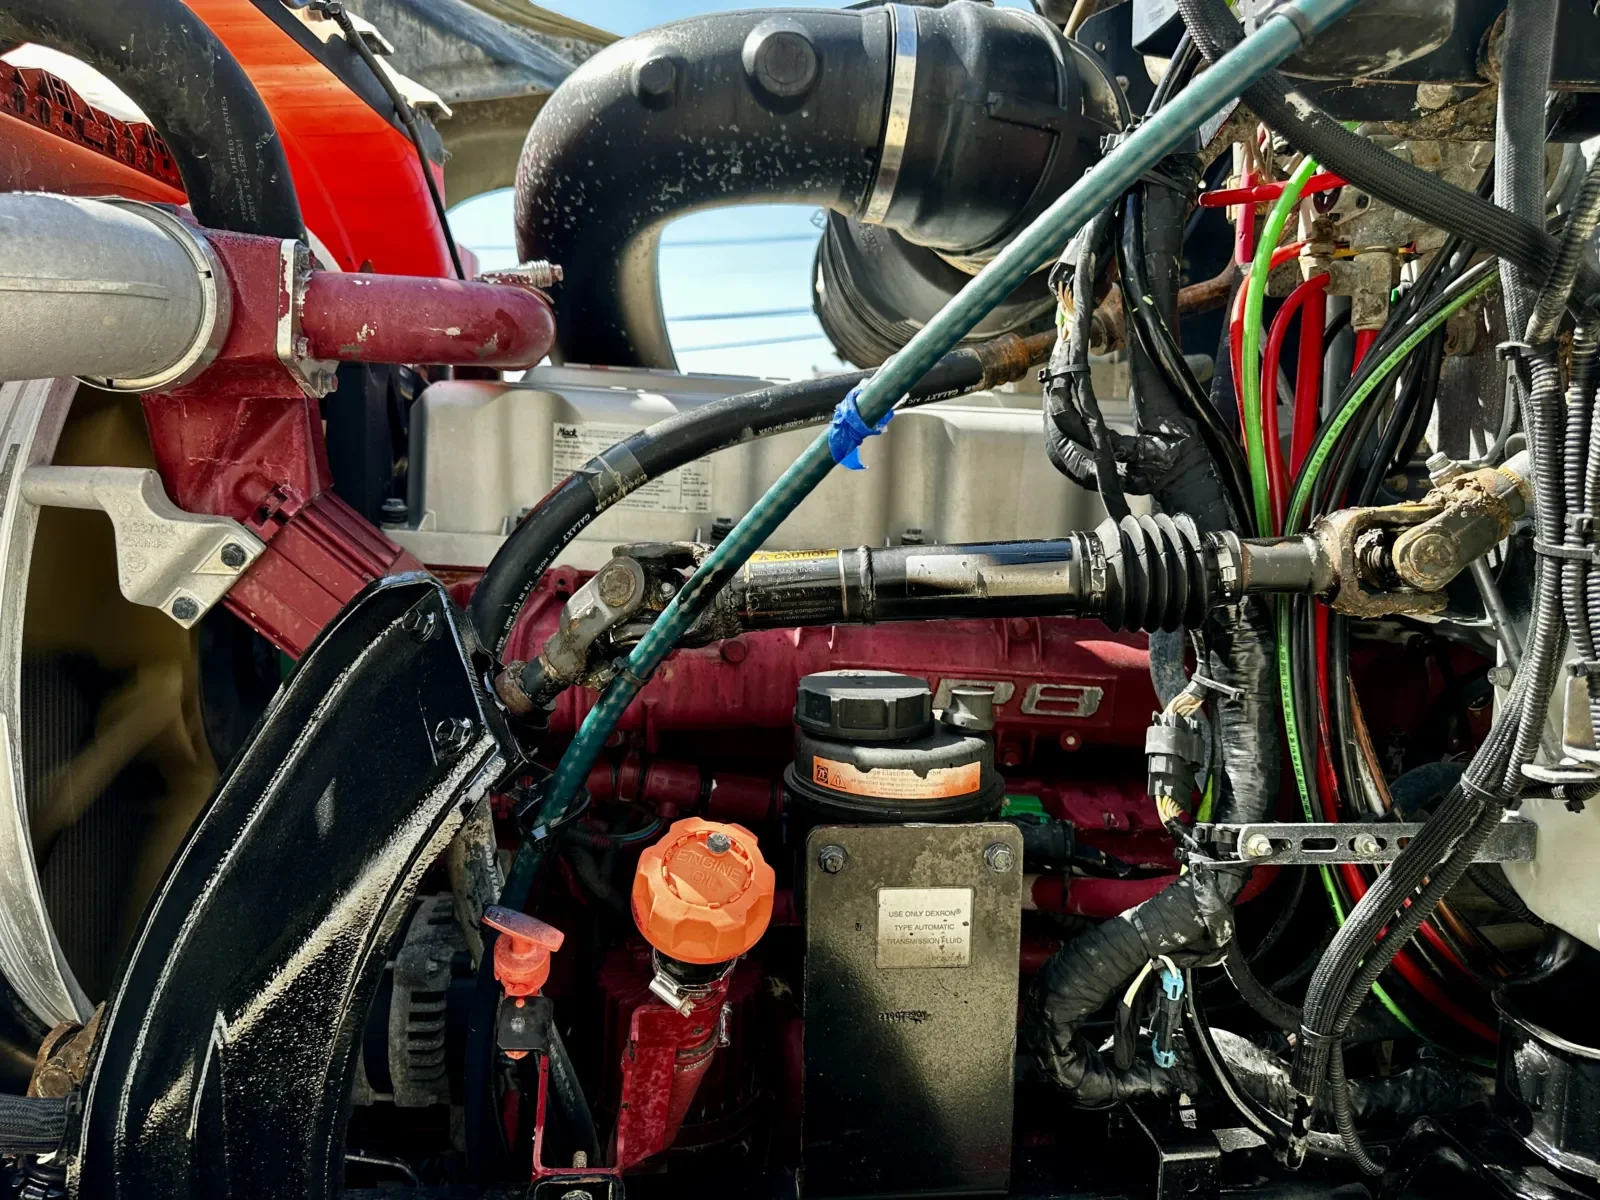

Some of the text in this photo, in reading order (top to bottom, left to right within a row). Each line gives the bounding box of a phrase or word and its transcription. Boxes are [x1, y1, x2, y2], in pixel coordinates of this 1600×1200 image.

[228, 139, 239, 173] UNITED
[924, 388, 959, 402] GALAXY
[784, 418, 804, 427] MADE
[557, 427, 578, 438] Mack
[758, 426, 772, 434] USA
[562, 513, 591, 543] GALAXY
[549, 543, 561, 555] A/C
[774, 551, 829, 559] CAUTION
[535, 556, 549, 575] HOSE
[524, 579, 533, 591] 7/8
[517, 592, 525, 600] IN
[503, 615, 513, 630] MM)
[484, 844, 502, 900] OODYEAR
[675, 849, 744, 883] ENGINE
[691, 869, 717, 892] OIL
